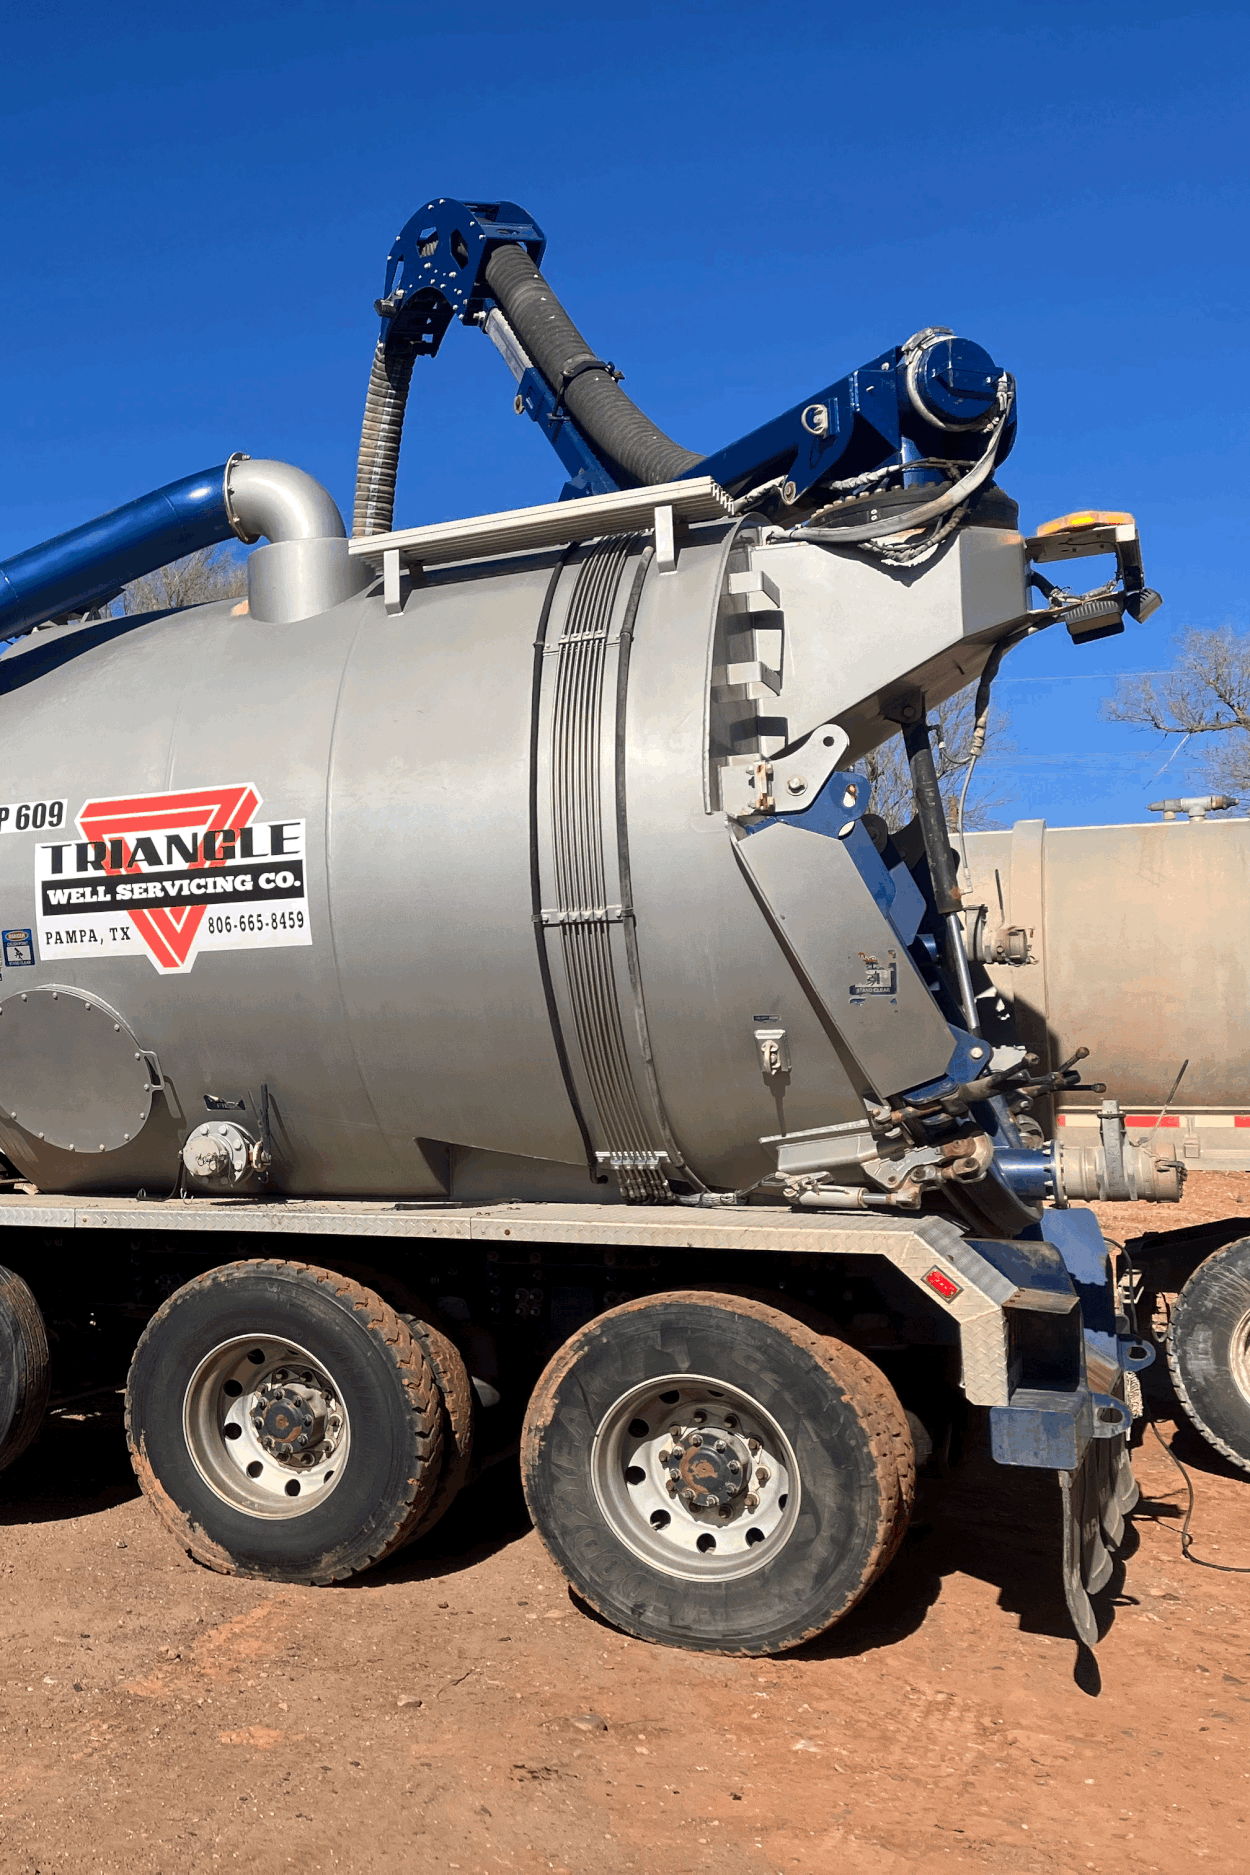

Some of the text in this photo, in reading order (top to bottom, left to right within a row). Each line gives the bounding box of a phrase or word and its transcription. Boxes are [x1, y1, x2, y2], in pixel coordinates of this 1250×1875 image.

[15, 800, 65, 831] 609
[40, 822, 301, 875] TRIANGLE
[46, 870, 302, 906] WELL SERVICING CO.
[45, 926, 131, 946] PAMPA, TX
[208, 910, 304, 935] 806-665-8459
